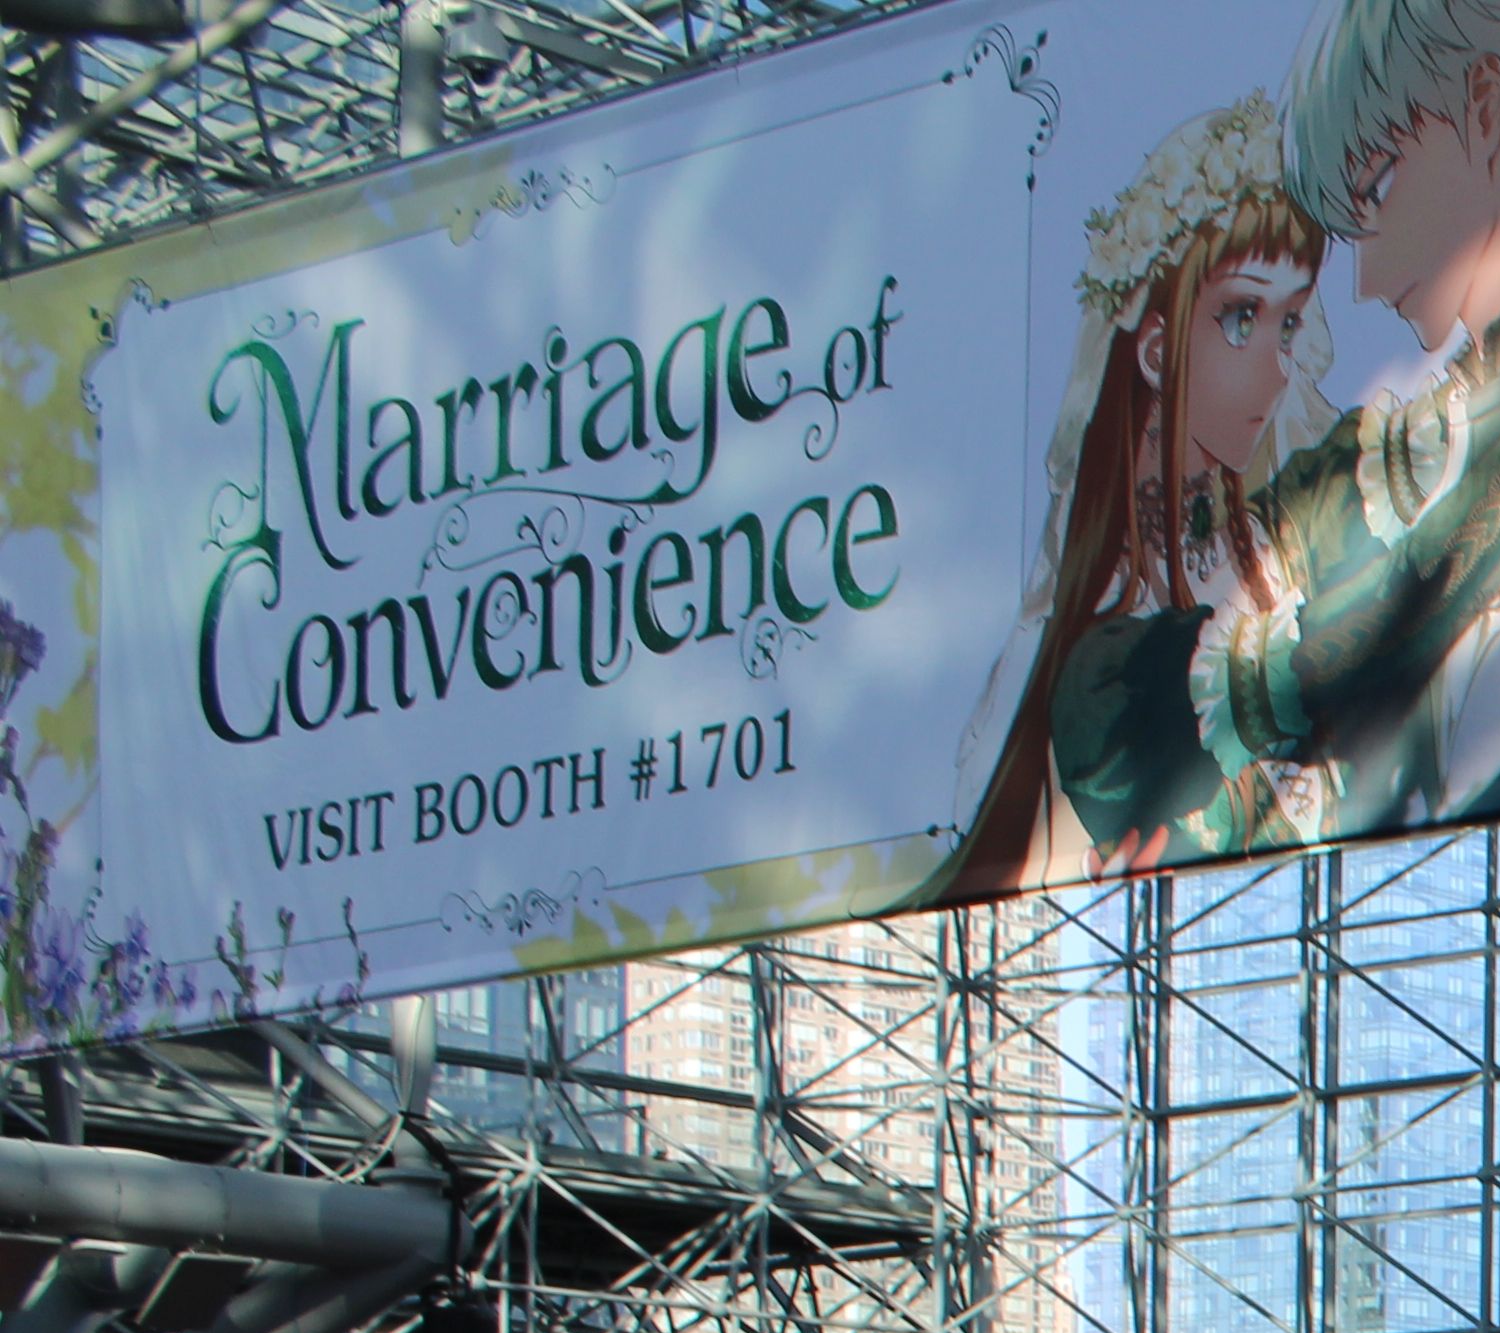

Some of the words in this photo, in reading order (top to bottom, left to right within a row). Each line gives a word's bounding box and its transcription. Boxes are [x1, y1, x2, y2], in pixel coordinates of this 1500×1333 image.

[207, 297, 800, 570] Marriage
[805, 274, 903, 462] of
[199, 483, 901, 744] Convenience
[262, 791, 395, 871] VISIT
[413, 748, 607, 845] BOOTH
[629, 708, 799, 803] #1701
